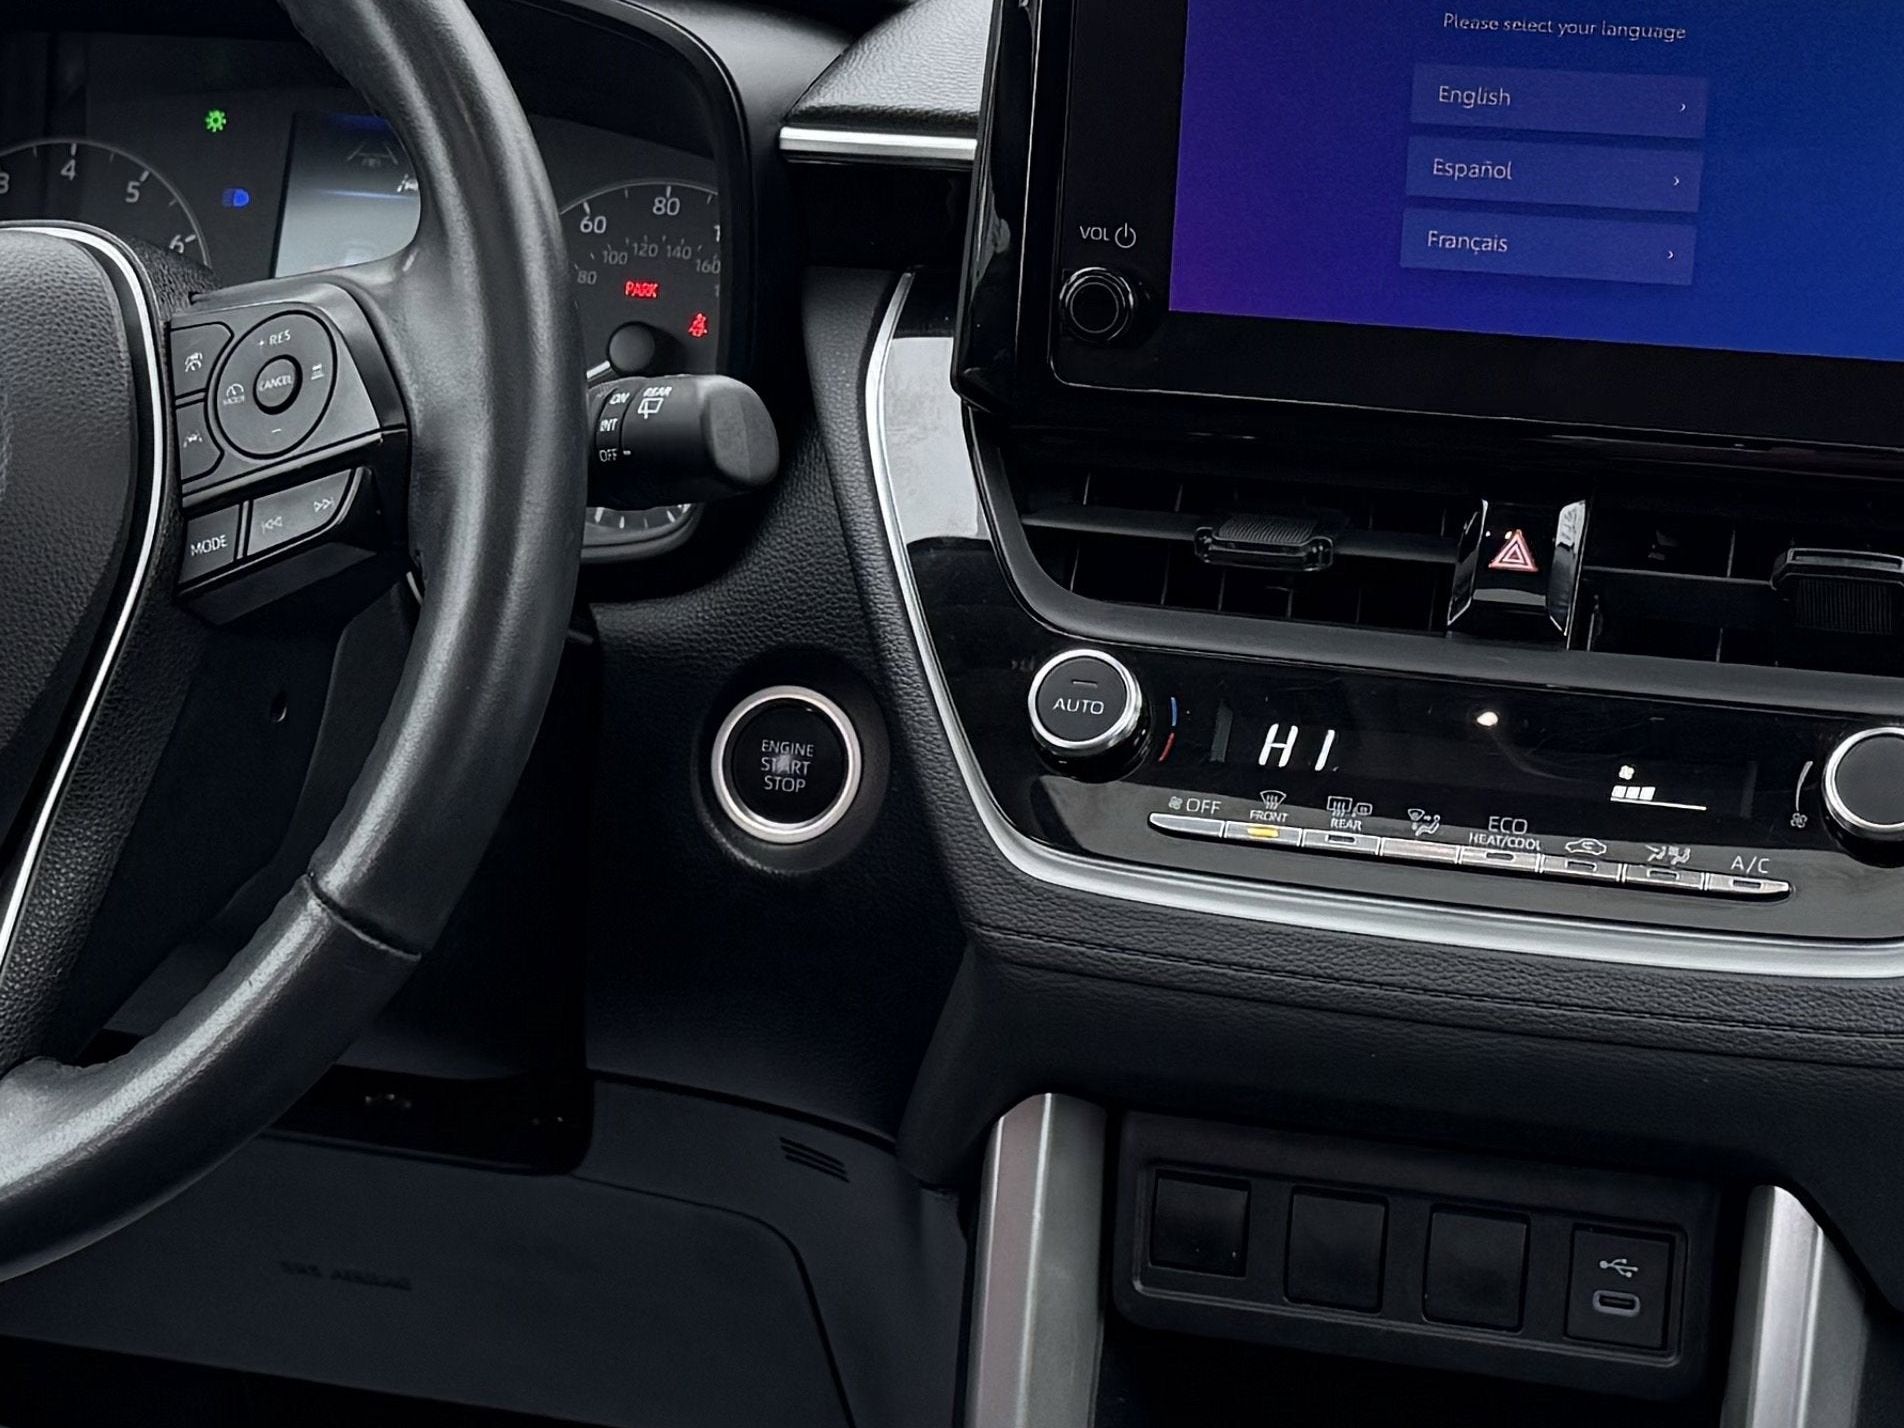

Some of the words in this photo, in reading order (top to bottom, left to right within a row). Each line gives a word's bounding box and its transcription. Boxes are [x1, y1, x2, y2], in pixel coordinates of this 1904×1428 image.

[1443, 12, 1499, 31] Please
[1503, 18, 1553, 33] select
[1558, 22, 1597, 38] your
[1601, 20, 1687, 43] language
[1438, 85, 1512, 109] English
[60, 159, 76, 181] 4
[1432, 158, 1513, 180] Español
[125, 181, 140, 203] 5
[652, 197, 680, 216] 80
[579, 215, 607, 234] 60
[1079, 225, 1110, 241] VOL
[1427, 230, 1508, 255] Français
[602, 250, 628, 265] 100
[633, 243, 659, 257] 120
[667, 245, 692, 260] 140
[624, 280, 659, 298] PARK
[269, 329, 291, 346] RES
[258, 375, 293, 391] CANCEL
[642, 386, 673, 397] REAR
[608, 392, 631, 405] ON
[599, 418, 619, 432] INT
[599, 448, 618, 462] OFF
[190, 534, 228, 556] MODE
[1052, 697, 1105, 715] AUTO
[761, 739, 815, 758] ENGINE
[1258, 722, 1336, 772] HI
[760, 757, 811, 776] START
[763, 775, 807, 793] STOP
[1186, 798, 1222, 815] OFF
[1249, 809, 1289, 823] FRONT
[1330, 817, 1362, 831] REAR
[1488, 815, 1528, 835] ECO
[1469, 832, 1542, 852] HEAT/COOL
[1731, 855, 1771, 874] A/C
